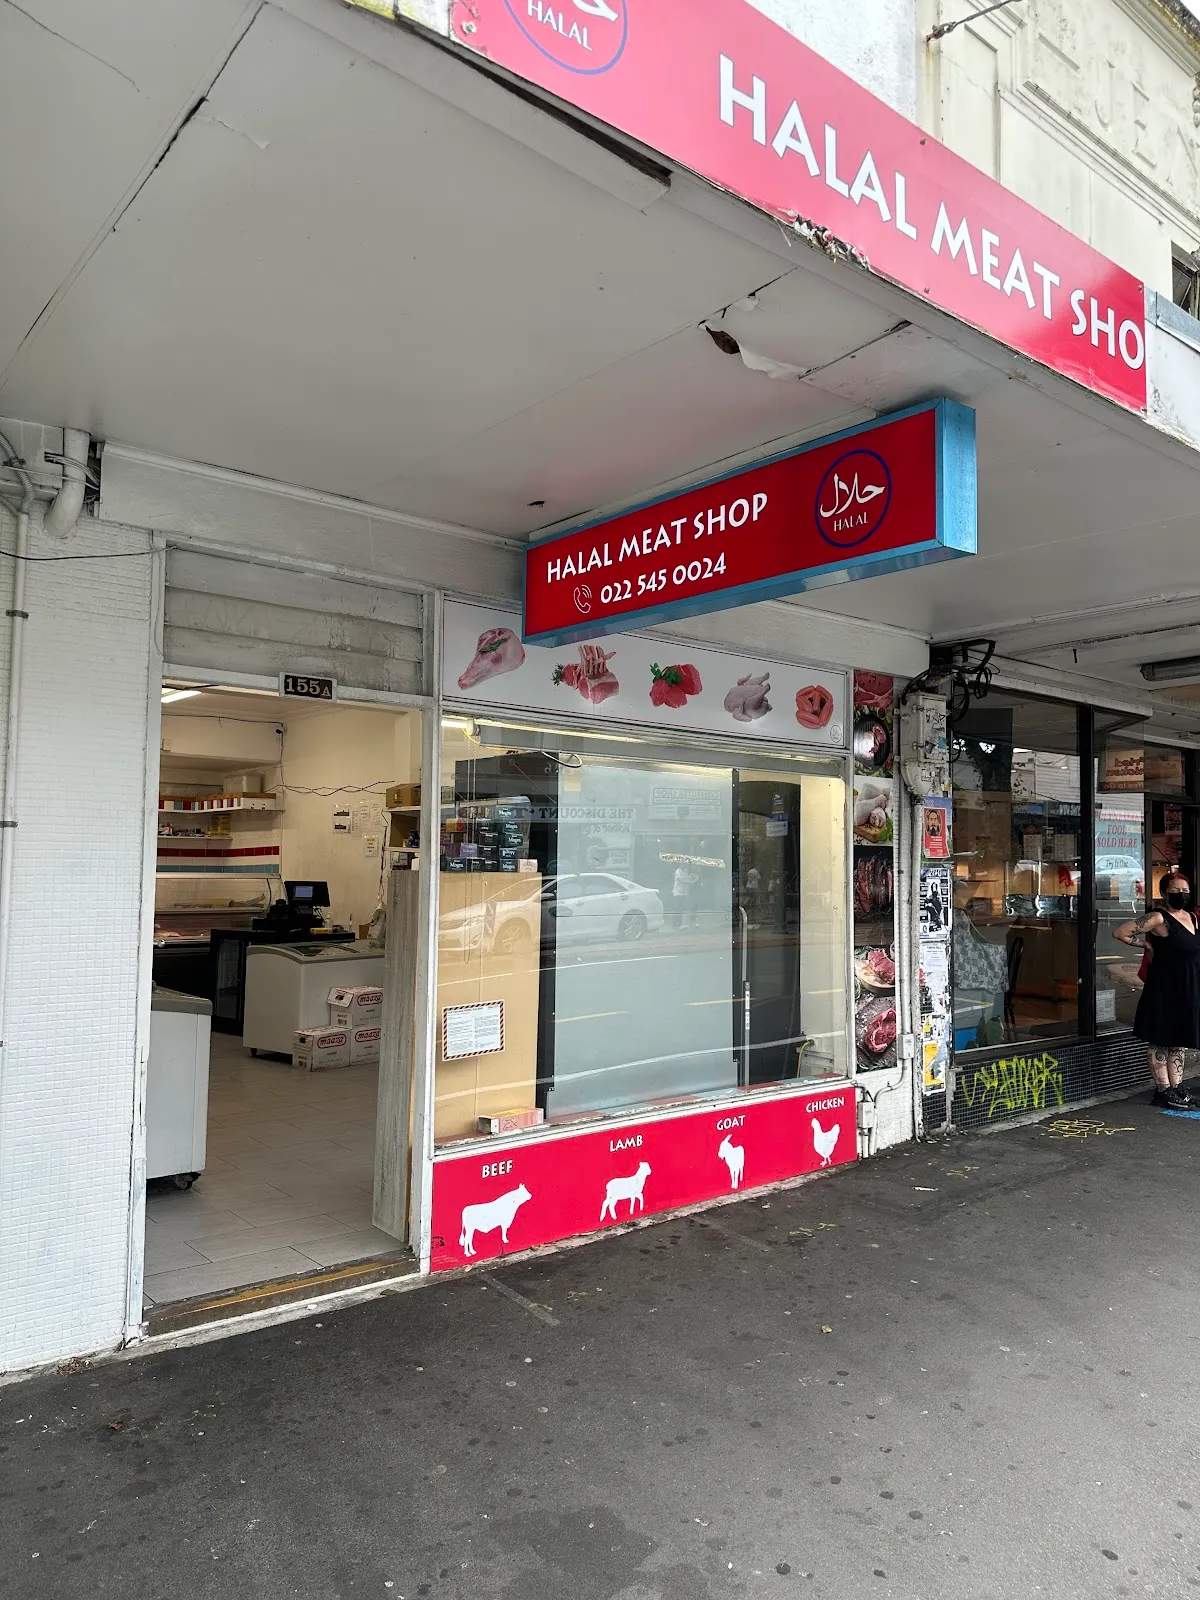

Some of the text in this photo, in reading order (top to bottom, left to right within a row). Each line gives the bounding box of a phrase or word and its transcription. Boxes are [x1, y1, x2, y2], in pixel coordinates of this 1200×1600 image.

[527, 0, 593, 51] HALAL
[719, 53, 917, 240] HALAL
[930, 201, 1060, 320] MEAT
[820, 472, 886, 518] حلال
[833, 511, 869, 532] HALAL
[547, 493, 768, 583] HALAL MEAT SHOP
[600, 552, 727, 604] 022 545 0024
[286, 677, 332, 697] 155A
[805, 1097, 845, 1114] CHICKEN
[716, 1114, 747, 1132] GOAT
[610, 1134, 644, 1153] LAMB
[481, 1159, 513, 1179] BEEF
